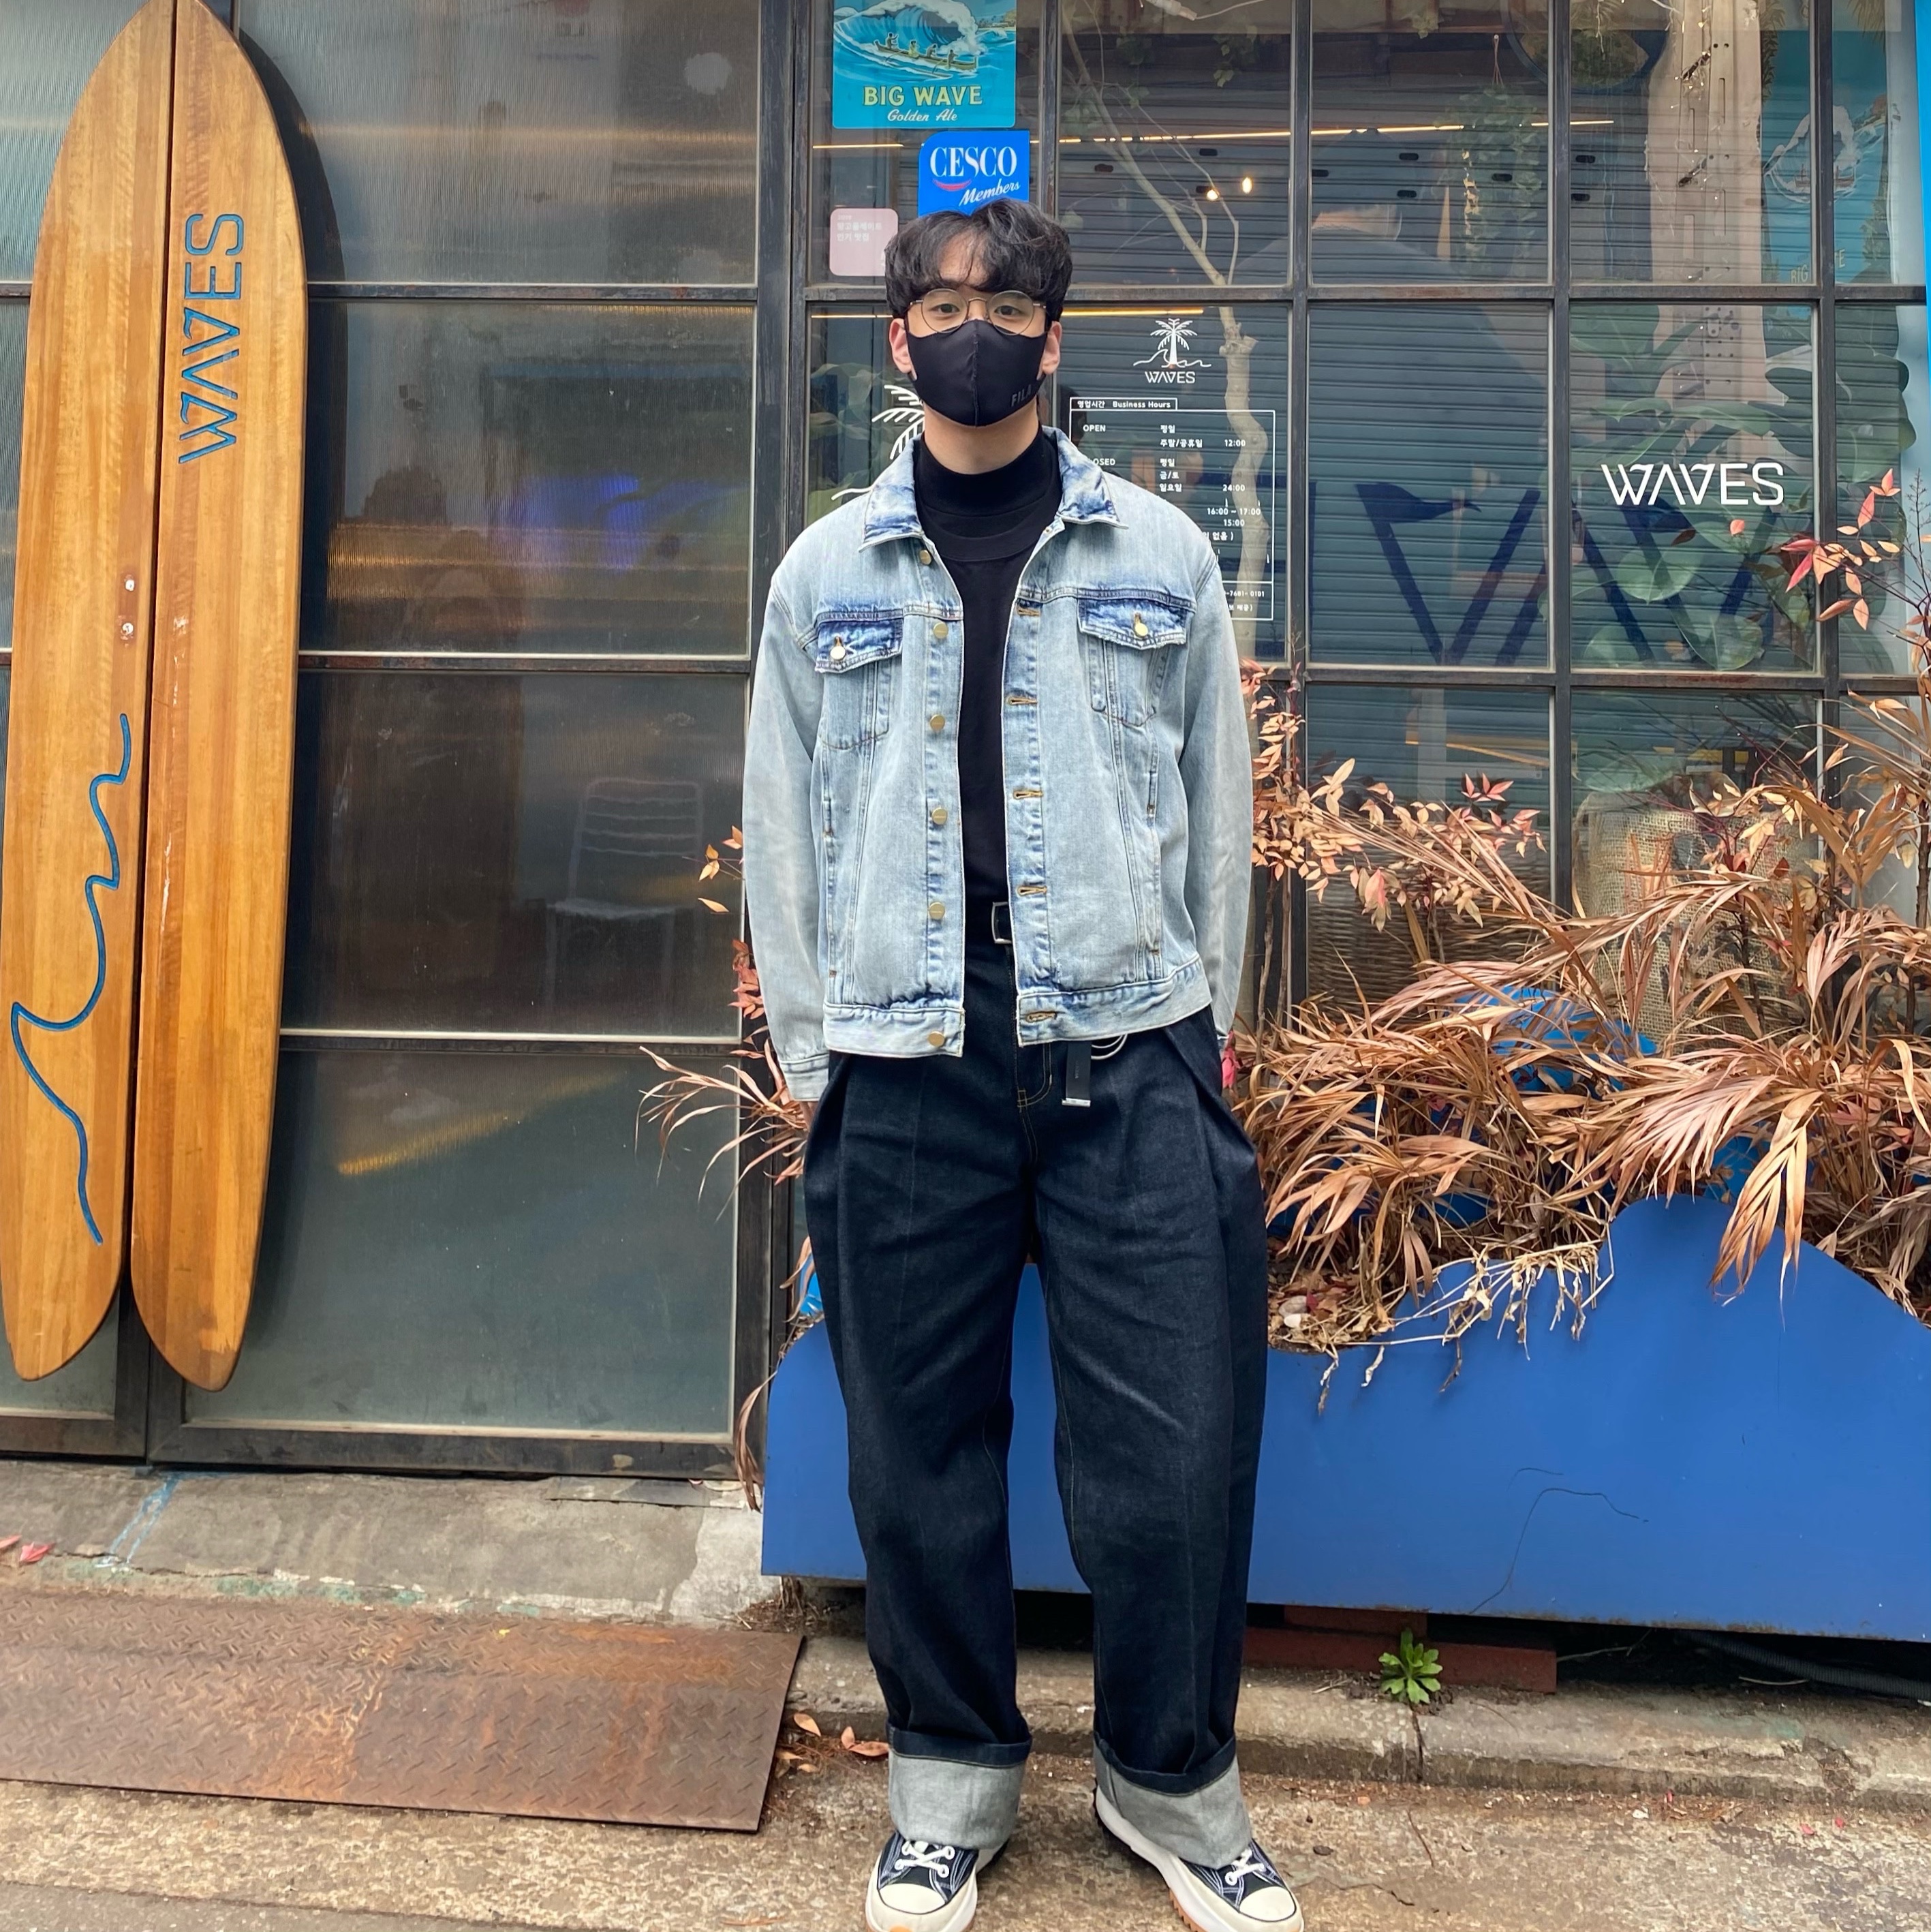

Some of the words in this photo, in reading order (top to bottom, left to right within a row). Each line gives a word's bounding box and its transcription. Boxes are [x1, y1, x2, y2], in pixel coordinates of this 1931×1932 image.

[862, 86, 905, 106] BIG
[914, 86, 983, 106] WAVE
[887, 108, 929, 122] Golden
[936, 108, 957, 121] Ale
[929, 146, 1017, 178] CESCO
[958, 179, 1021, 207] Members
[179, 213, 244, 464] WAVES
[1145, 371, 1196, 384] WAVES
[1077, 401, 1106, 409] 영업시간
[1160, 425, 1175, 433] 평일
[1160, 439, 1203, 448] 주말/공휴일
[1160, 458, 1175, 467] 평일
[1160, 471, 1179, 480] 금/토
[1160, 483, 1182, 492] 일요일
[1222, 484, 1246, 492] 24:00
[1601, 463, 1784, 506] WAVES
[1223, 519, 1245, 527] 15:00
